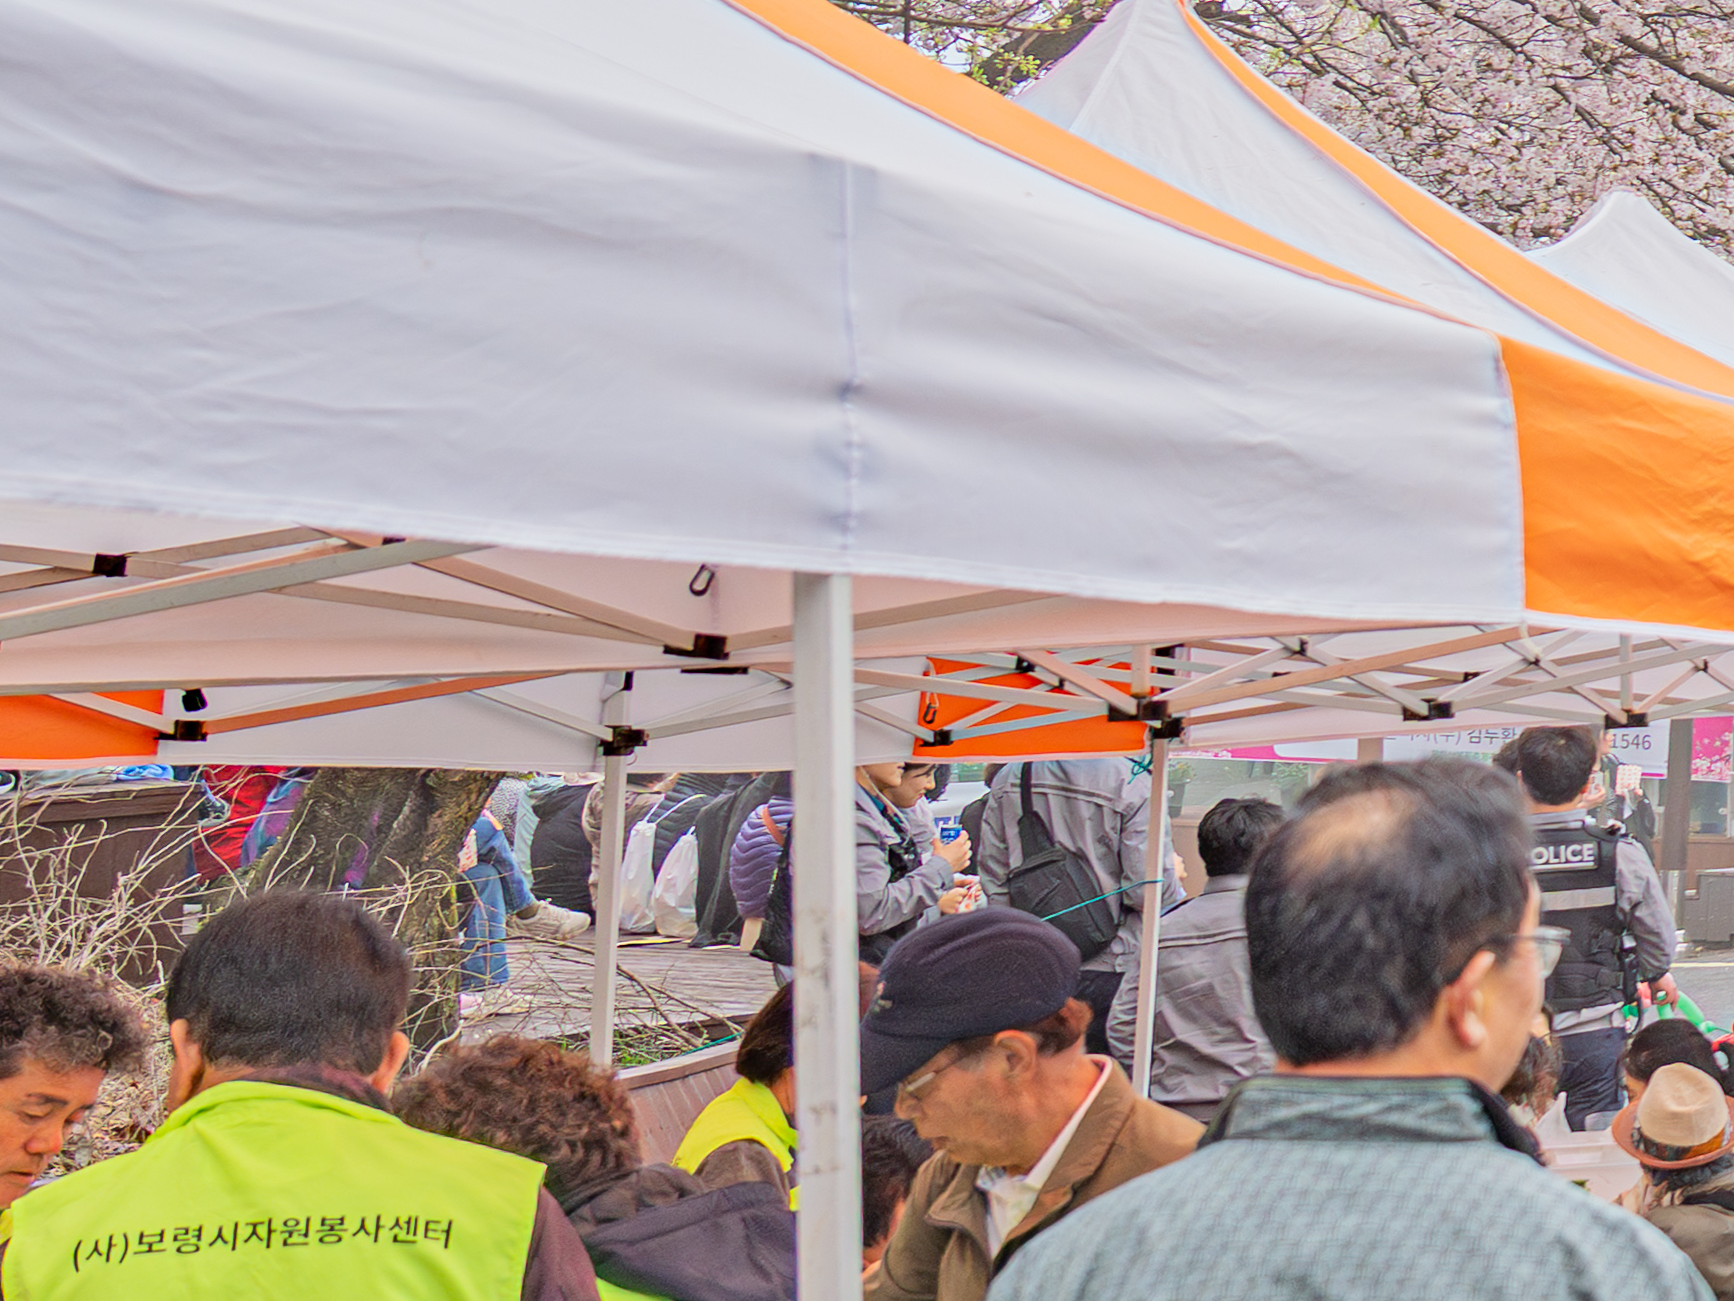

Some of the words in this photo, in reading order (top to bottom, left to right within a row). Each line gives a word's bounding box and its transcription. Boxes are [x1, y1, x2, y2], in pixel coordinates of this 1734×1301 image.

[1610, 733, 1652, 750] 1546
[1530, 843, 1596, 864] OLICE
[73, 1213, 455, 1272] (사)보령시자원봉사센터
